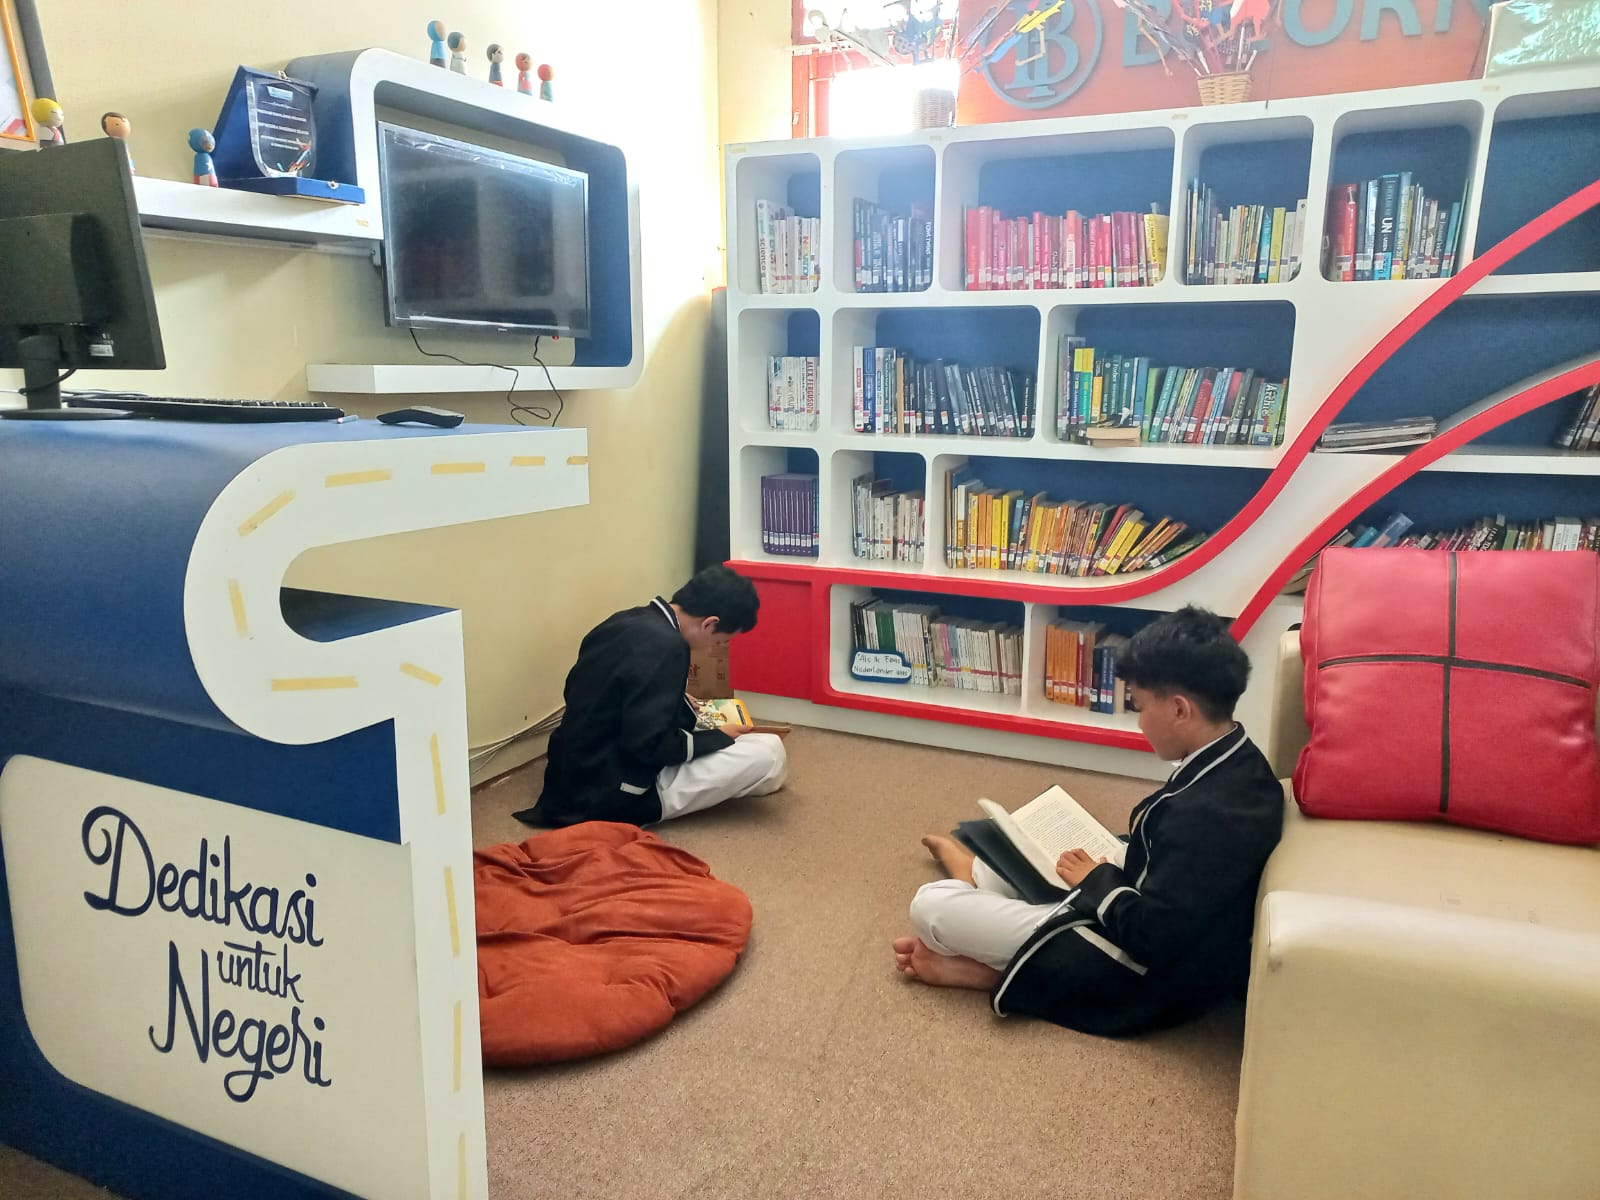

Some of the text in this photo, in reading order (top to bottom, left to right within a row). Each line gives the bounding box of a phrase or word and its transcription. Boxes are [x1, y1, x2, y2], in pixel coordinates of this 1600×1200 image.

[81, 805, 324, 947] Dedikasi
[148, 940, 332, 1103] Negeri
[216, 940, 304, 1003] untuk
